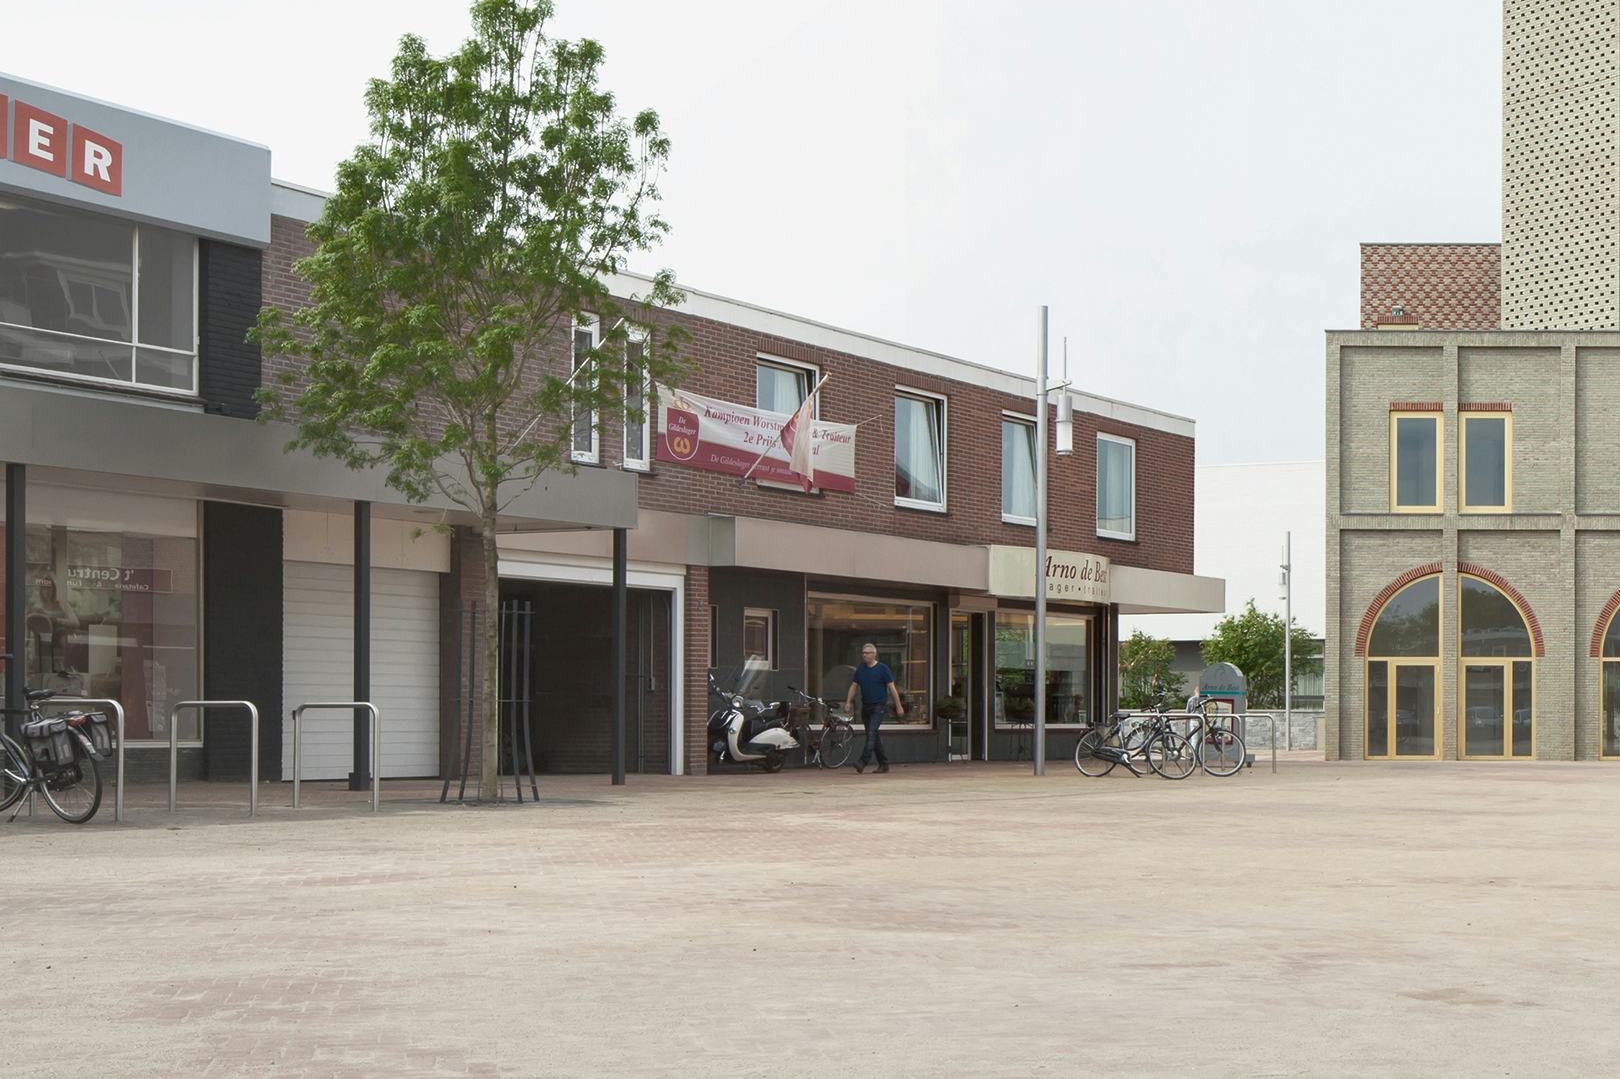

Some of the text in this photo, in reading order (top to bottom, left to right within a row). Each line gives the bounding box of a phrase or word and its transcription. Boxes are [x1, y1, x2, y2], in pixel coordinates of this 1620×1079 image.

[704, 405, 750, 426] Kampioen
[744, 431, 753, 443] 2e
[1080, 560, 1093, 581] de
[1049, 583, 1074, 594] ager
